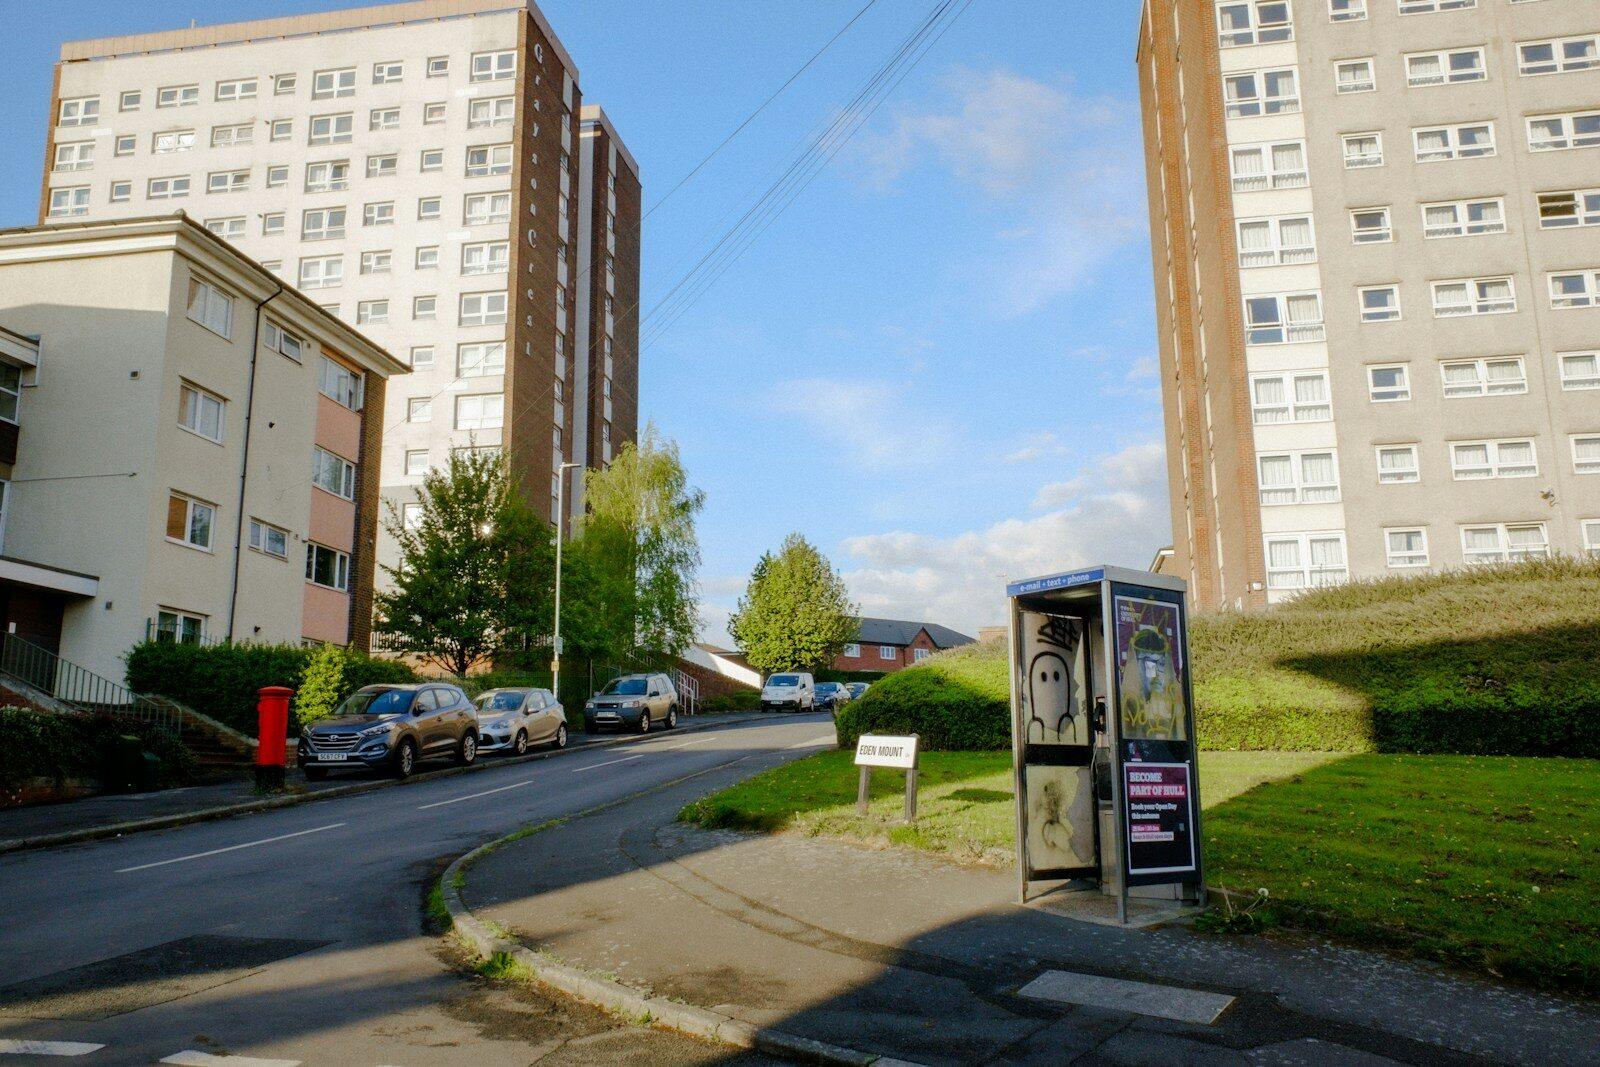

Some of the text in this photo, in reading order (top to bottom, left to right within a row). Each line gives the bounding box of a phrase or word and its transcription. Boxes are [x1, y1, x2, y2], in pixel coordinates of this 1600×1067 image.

[1020, 573, 1090, 592] e-mail text phone
[859, 745, 877, 756] EDEN
[877, 746, 903, 757] MOUNT
[1129, 772, 1163, 782] BECOME
[1129, 785, 1185, 796] PART OF HULL
[1155, 803, 1167, 811] Open
[1167, 803, 1177, 811] Day
